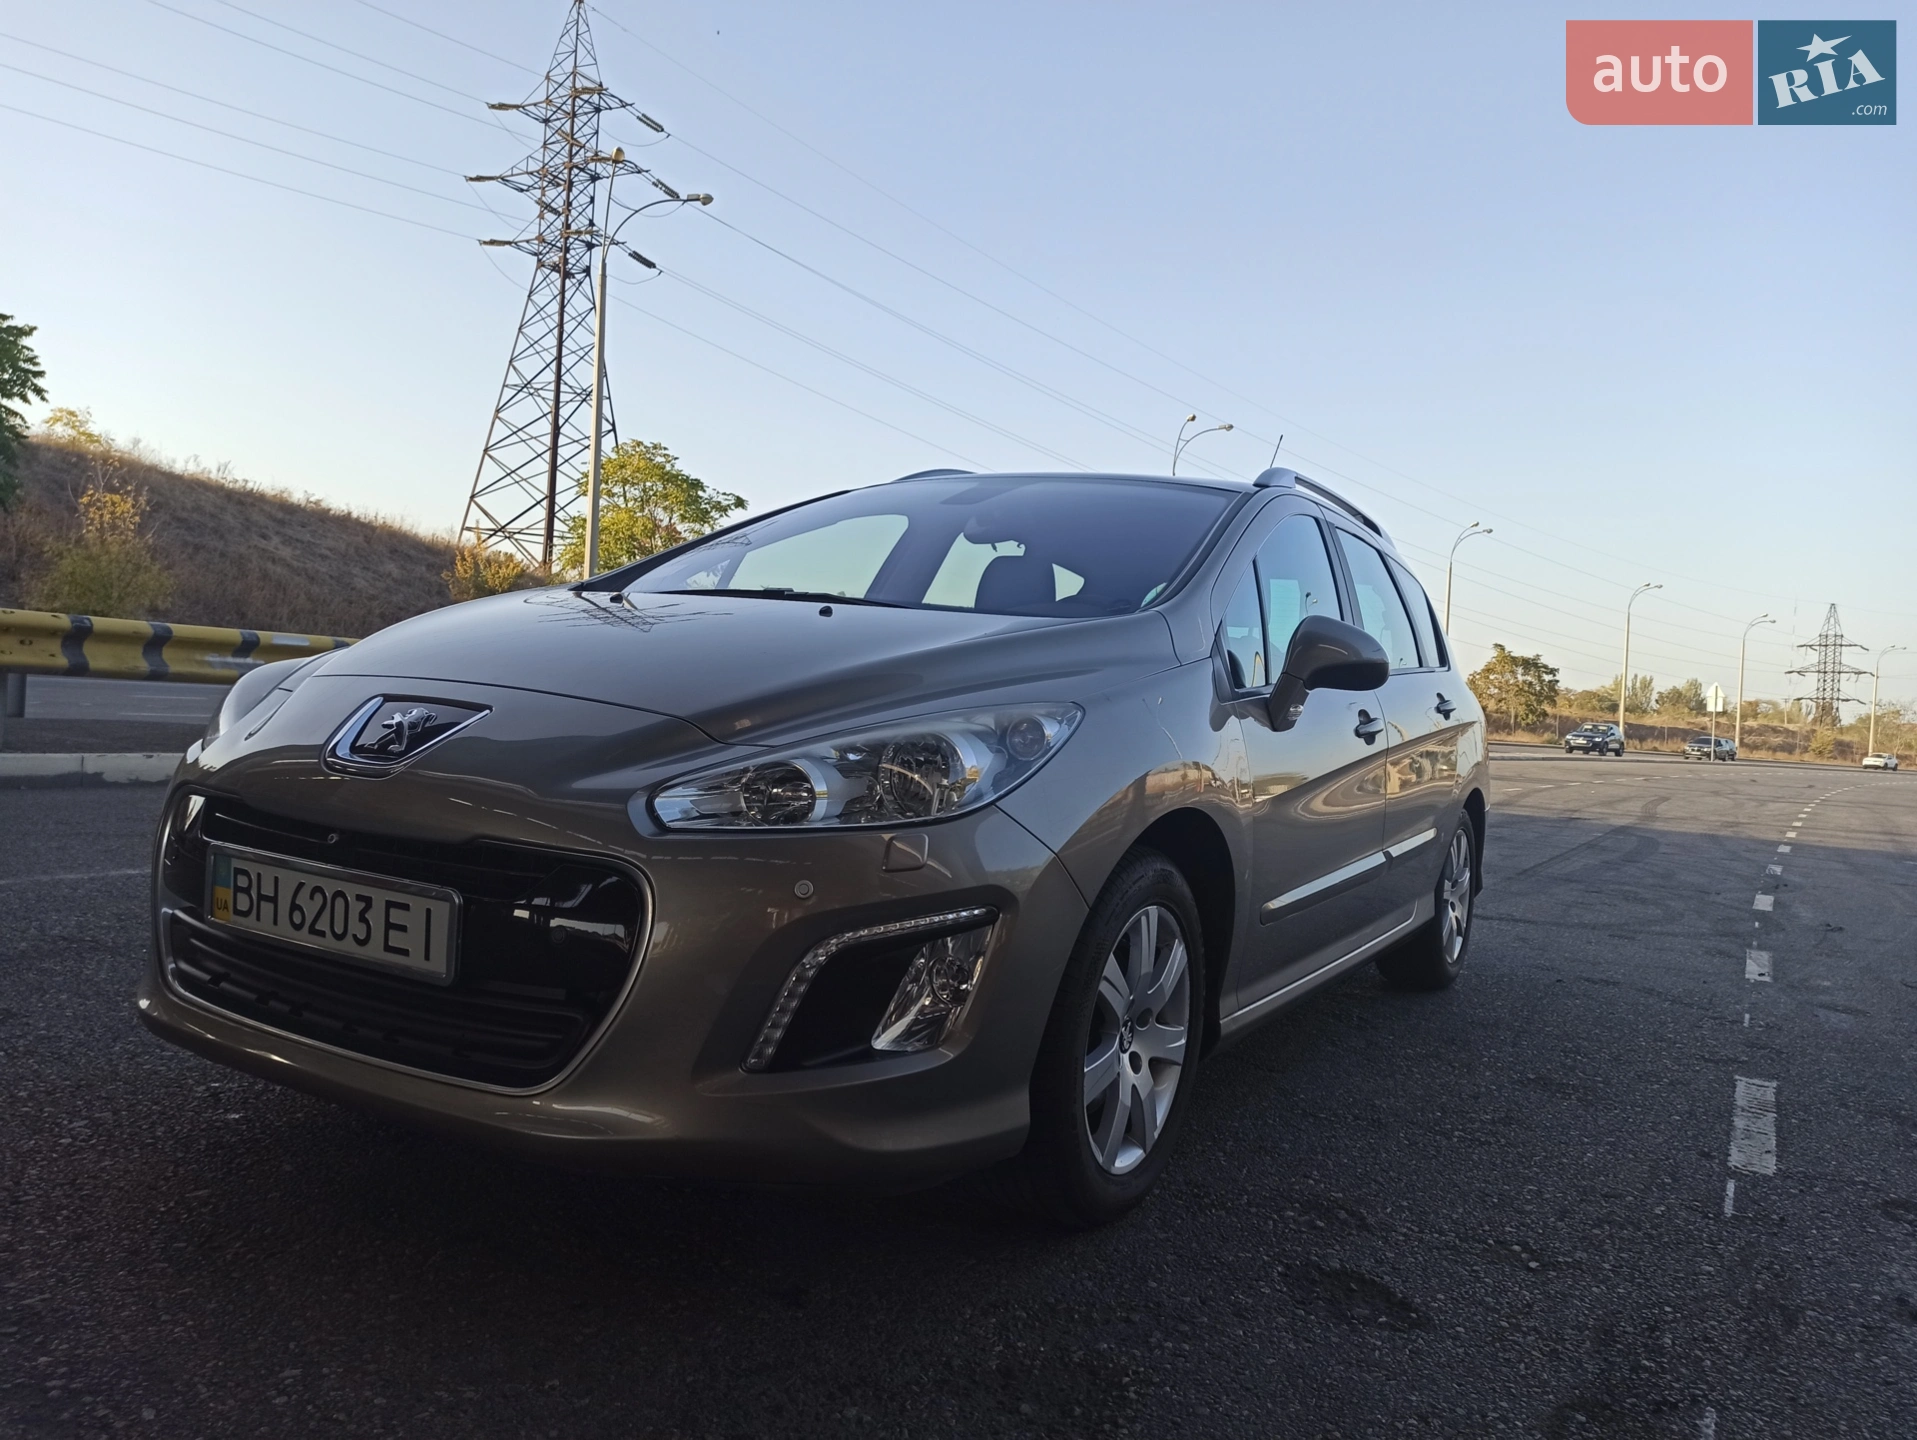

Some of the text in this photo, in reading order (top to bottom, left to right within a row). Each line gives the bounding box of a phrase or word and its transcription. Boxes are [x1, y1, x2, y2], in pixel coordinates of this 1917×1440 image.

[216, 896, 230, 912] UA
[232, 866, 432, 962] BH 6203 EI
